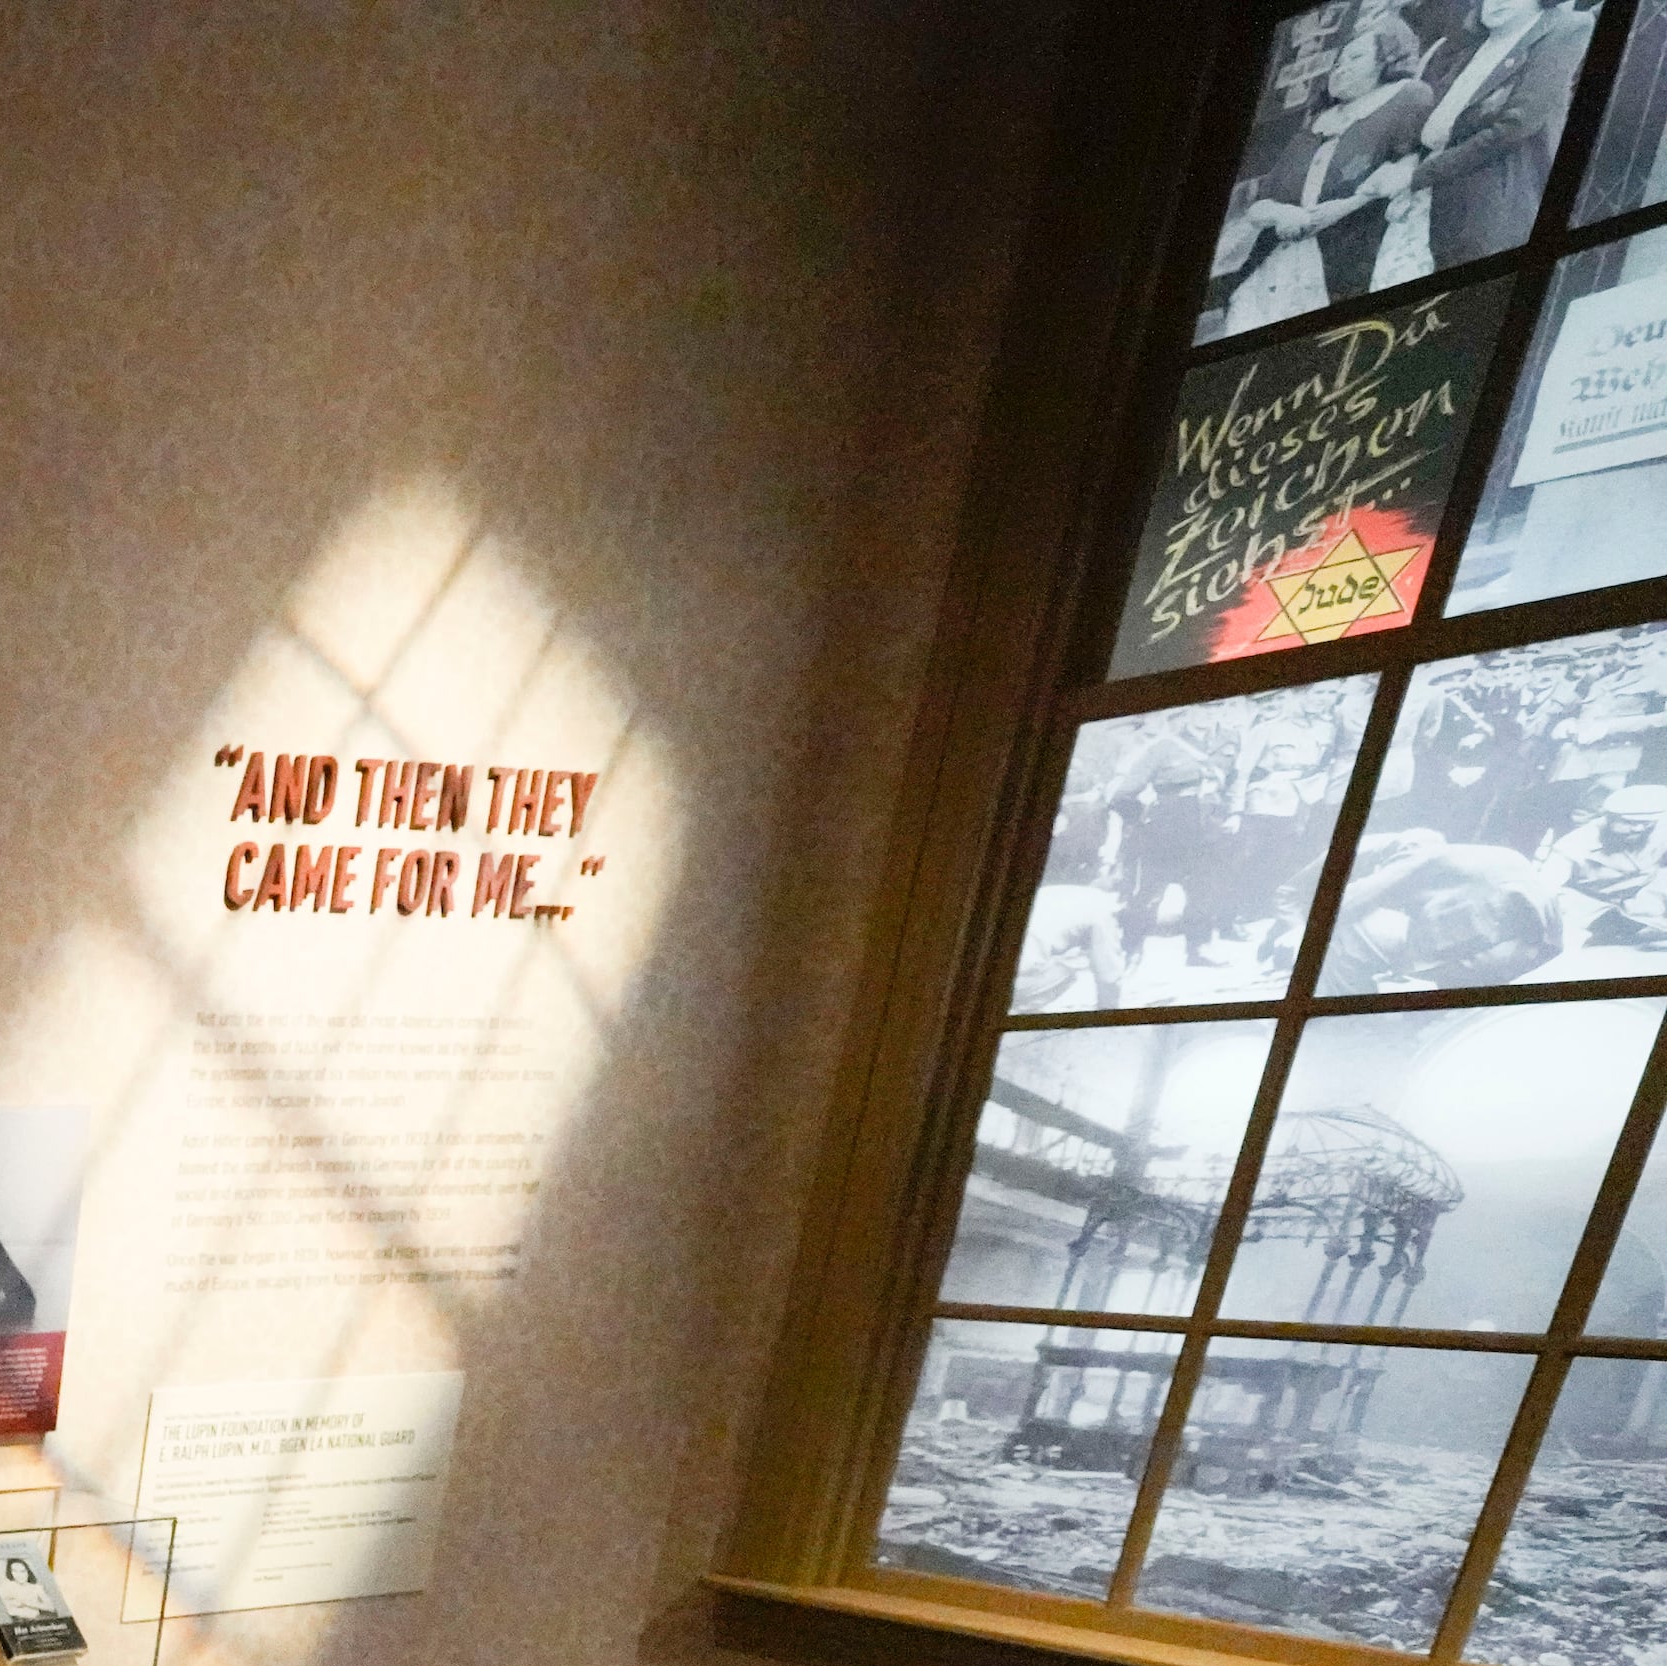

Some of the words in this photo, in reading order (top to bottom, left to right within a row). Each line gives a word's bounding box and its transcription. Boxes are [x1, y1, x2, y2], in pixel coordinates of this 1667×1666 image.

[1298, 574, 1380, 615] Jude
[355, 758, 474, 833] THEN
[486, 766, 599, 838] THEY
[223, 841, 363, 914] CAME
[369, 847, 460, 917] FOR
[163, 1425, 181, 1441] THE
[291, 1418, 302, 1431] IN
